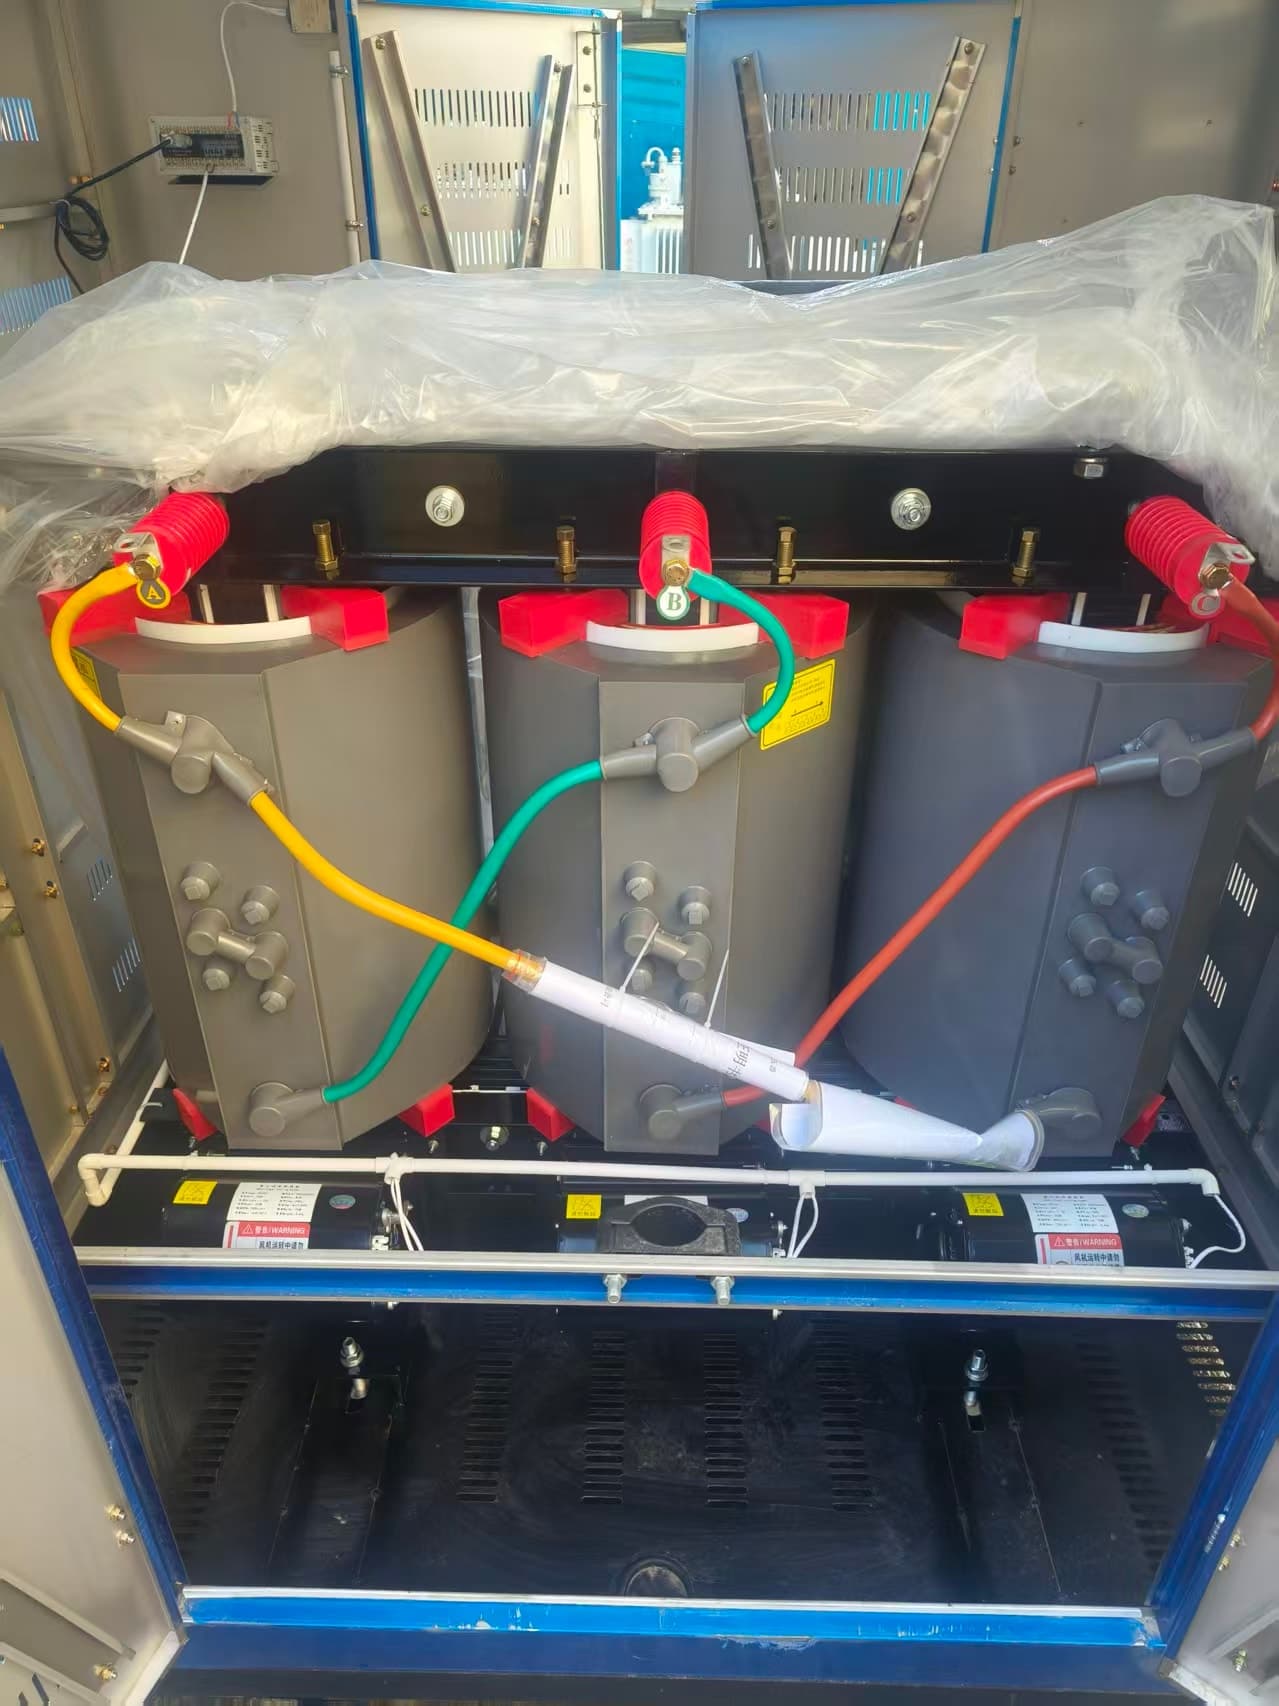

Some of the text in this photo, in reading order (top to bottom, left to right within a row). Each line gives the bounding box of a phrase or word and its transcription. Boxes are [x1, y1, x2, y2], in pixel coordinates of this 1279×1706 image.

[145, 584, 163, 600] A
[665, 591, 682, 611] B
[1197, 595, 1217, 611] C
